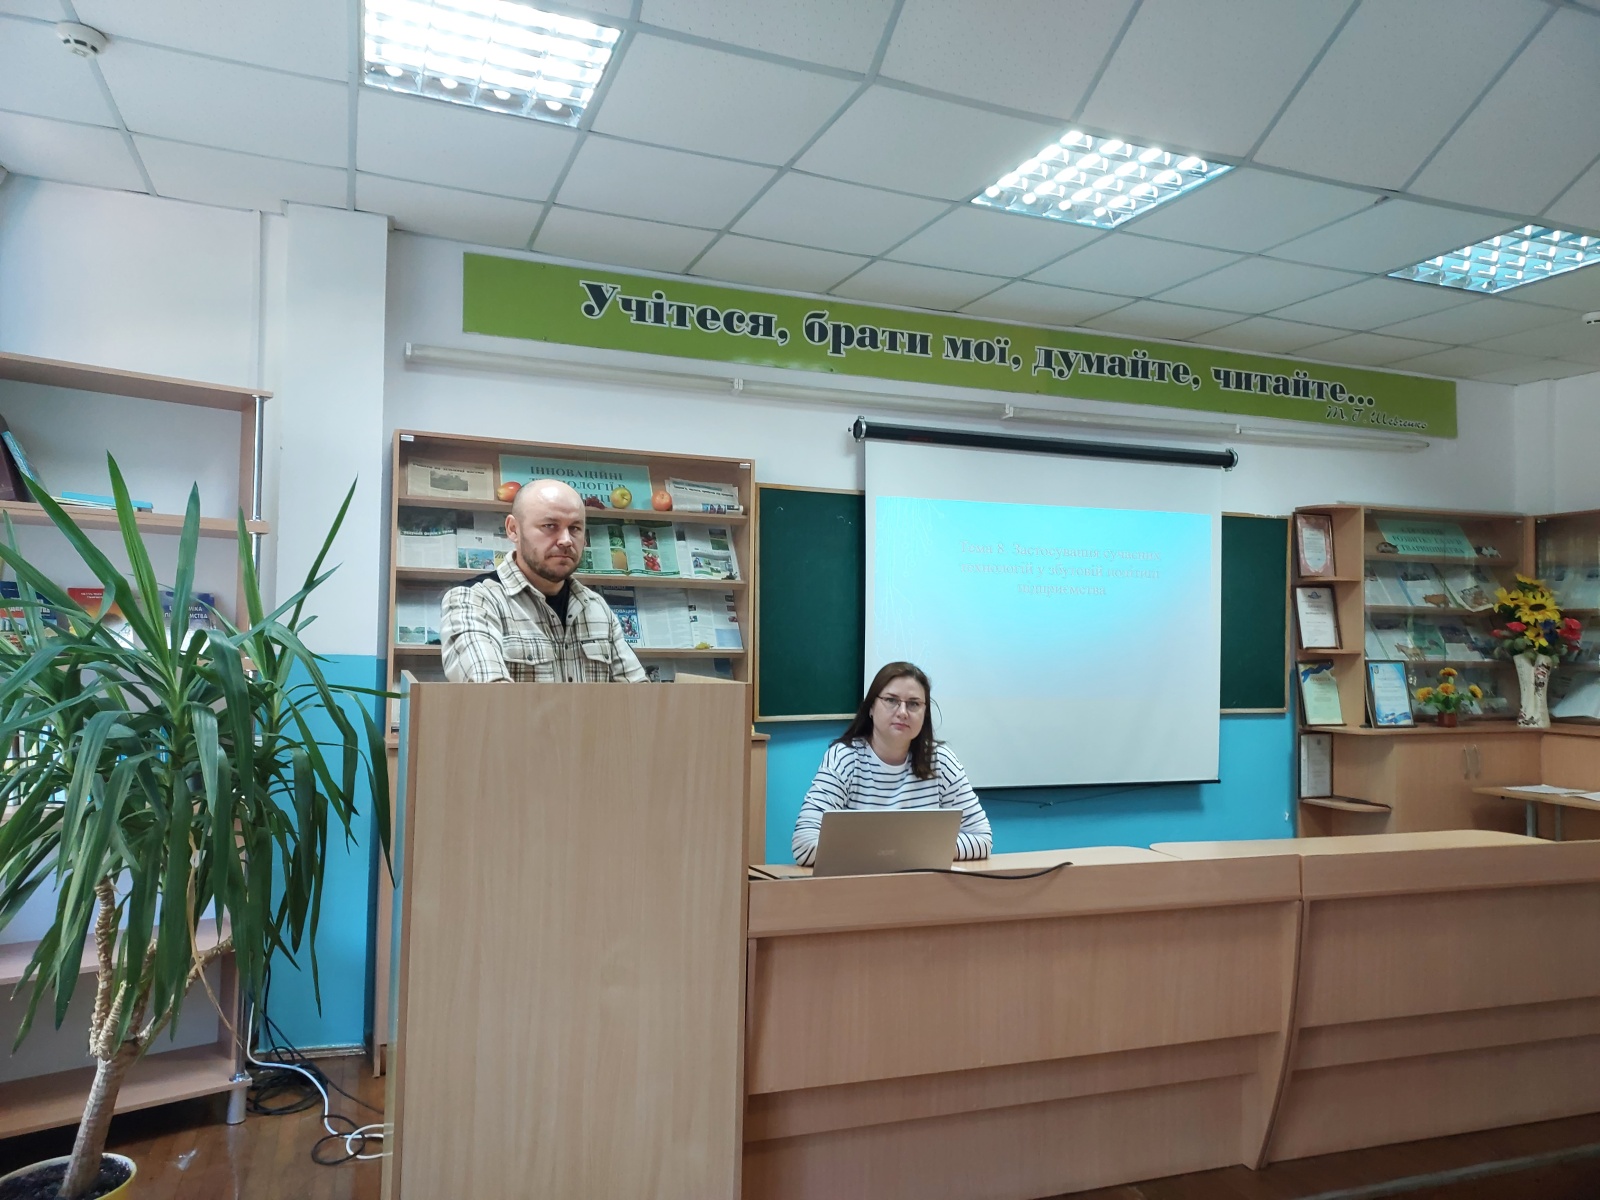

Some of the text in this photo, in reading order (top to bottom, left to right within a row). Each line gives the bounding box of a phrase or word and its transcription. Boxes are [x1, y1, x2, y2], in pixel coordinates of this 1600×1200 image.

[579, 279, 1377, 408] Учітеся, брати мої, думайте, читайте...
[1370, 411, 1428, 429] Шевченко
[530, 466, 624, 481] ІННОВАЦІЙНІ
[960, 540, 993, 554] Тема
[1012, 543, 1099, 560] Застосування
[1103, 548, 1162, 563] сучасних
[960, 561, 1033, 575] технологій
[1049, 562, 1103, 578] збутовій
